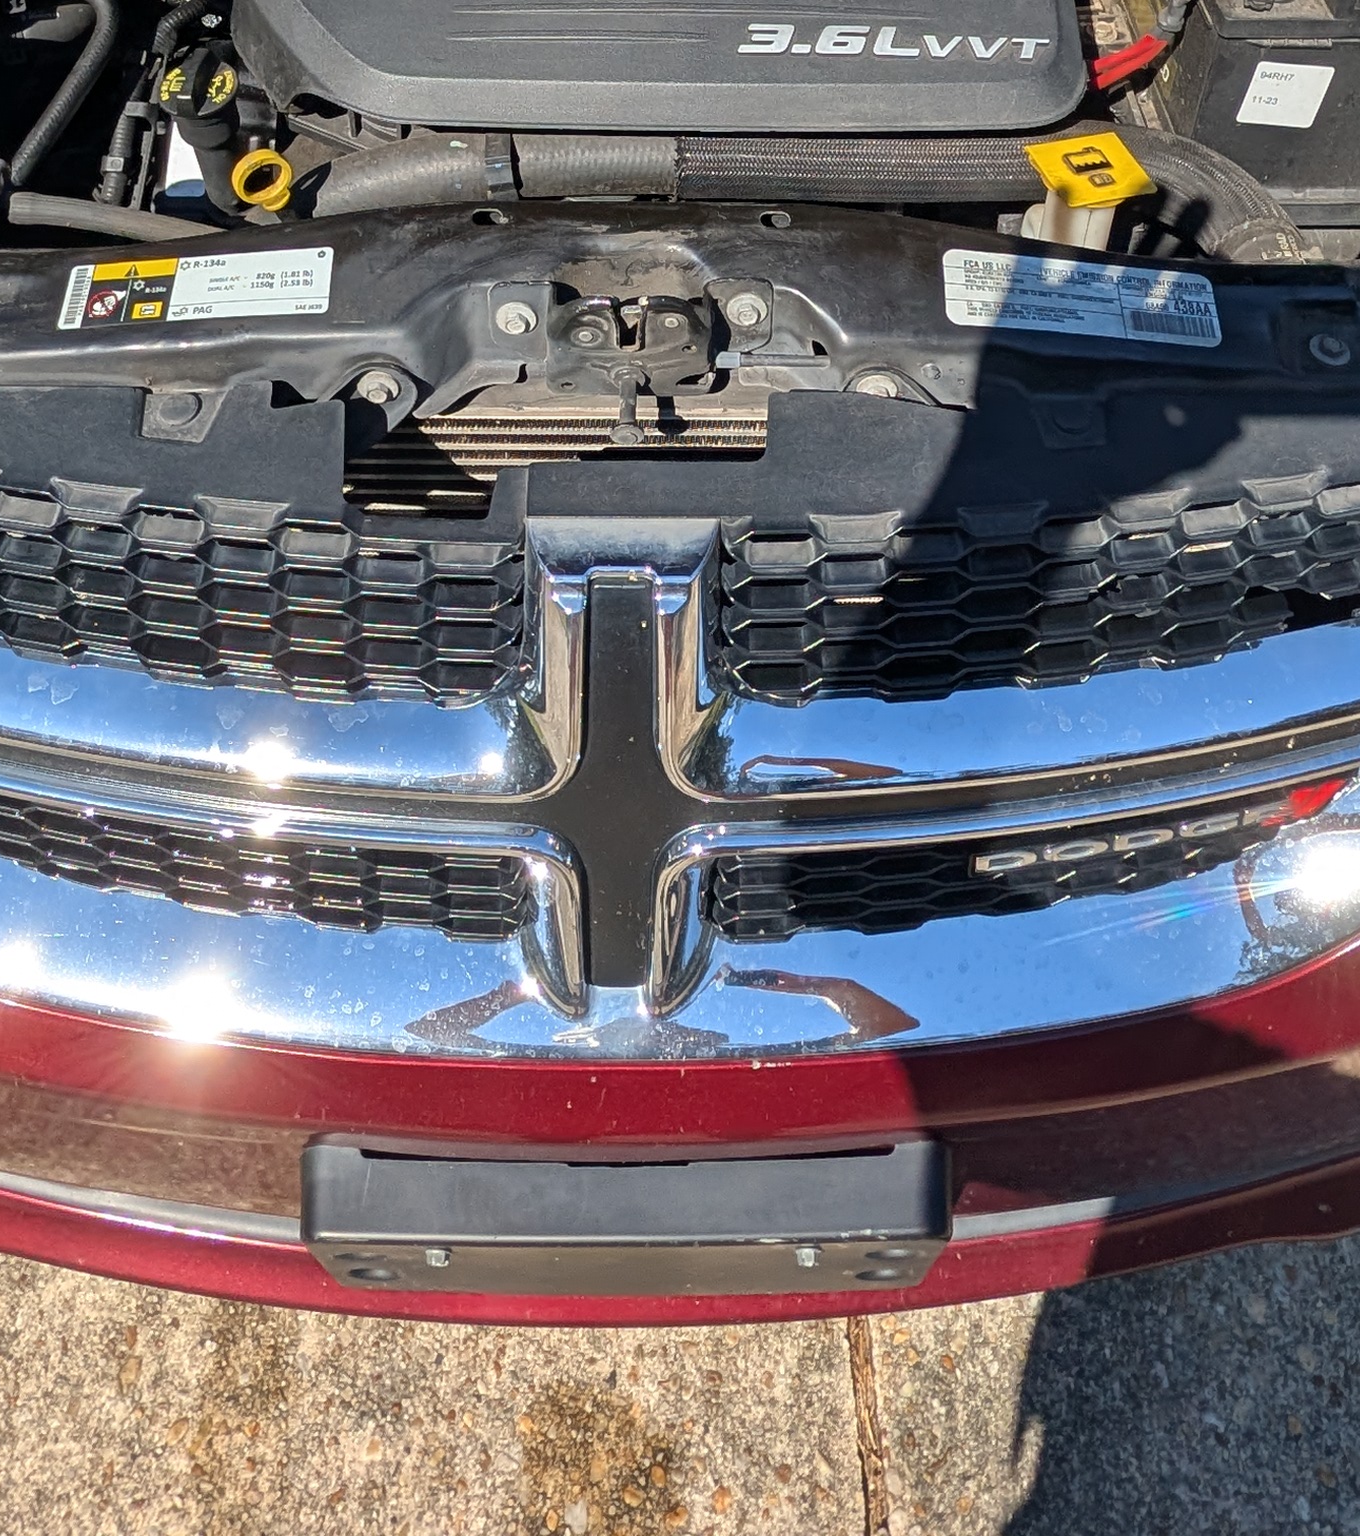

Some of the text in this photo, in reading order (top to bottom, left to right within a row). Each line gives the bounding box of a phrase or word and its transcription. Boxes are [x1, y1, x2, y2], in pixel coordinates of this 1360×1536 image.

[1251, 95, 1279, 106] 11-23
[193, 259, 226, 269] R-134a
[963, 259, 980, 268] FCA
[250, 280, 275, 289] 1150g
[192, 305, 213, 315] PAG
[1174, 298, 1212, 316] 438AA
